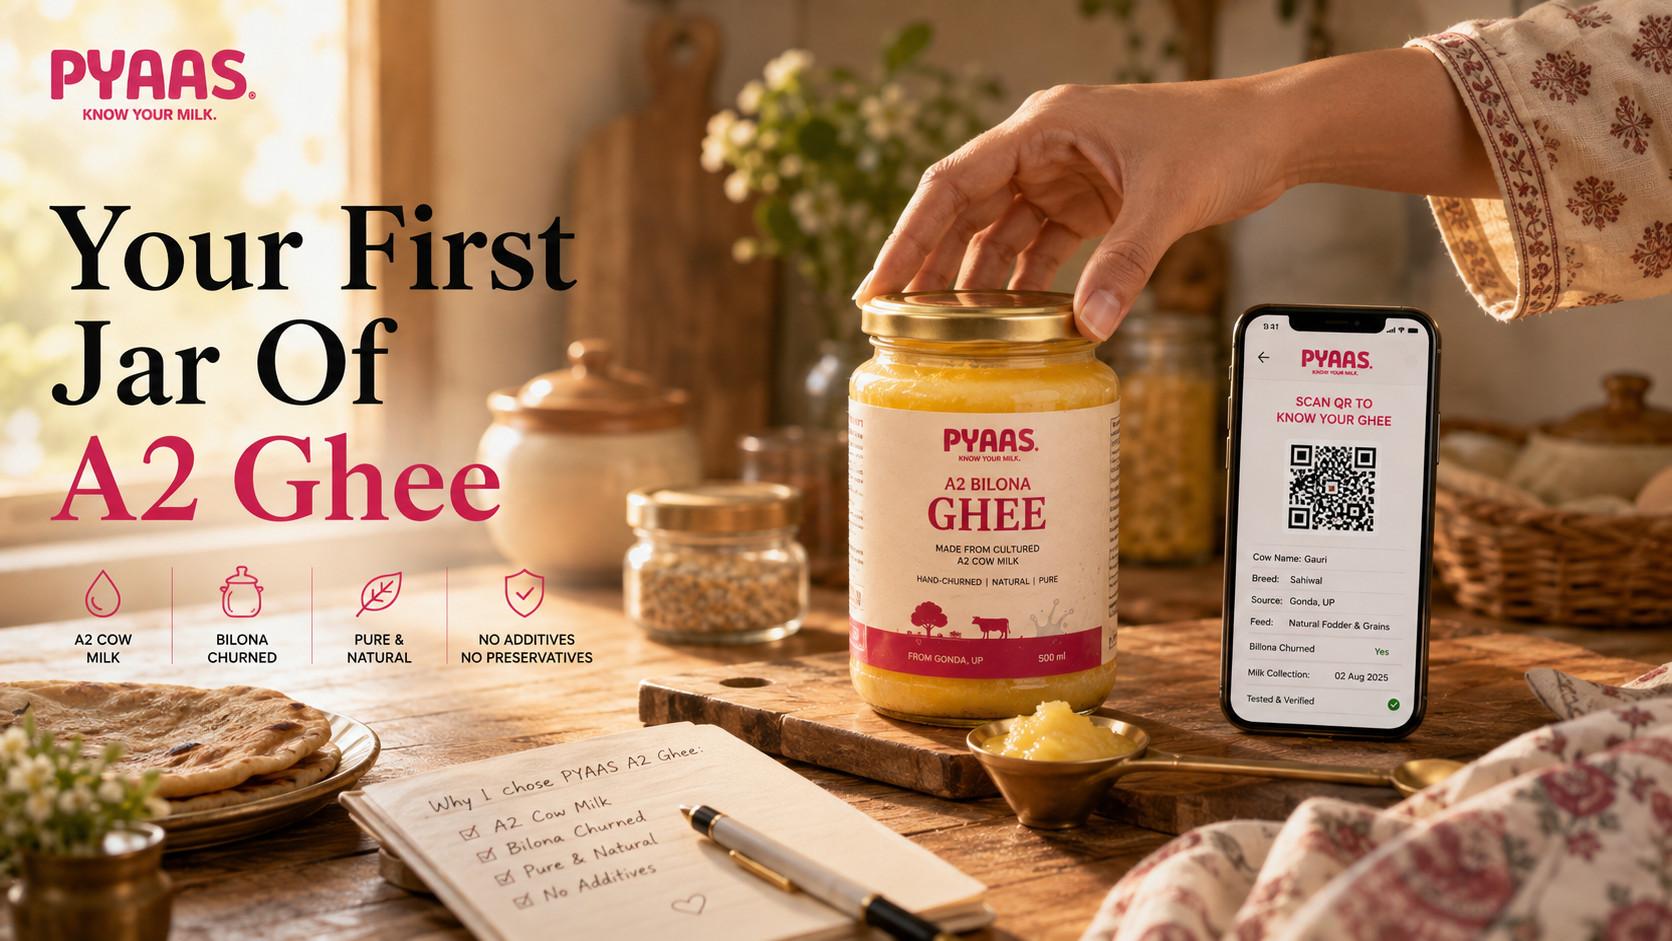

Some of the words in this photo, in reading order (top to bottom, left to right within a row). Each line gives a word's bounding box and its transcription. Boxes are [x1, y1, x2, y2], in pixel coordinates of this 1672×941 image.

[1295, 396, 1331, 408] SCAN
[1333, 397, 1352, 410] QR
[1355, 398, 1373, 409] TO
[1276, 412, 1317, 424] KNOW
[1319, 413, 1355, 426] YOUR
[1357, 415, 1392, 427] GHEE
[944, 477, 966, 491] A2
[971, 477, 1031, 491] BILONA
[927, 496, 1046, 532] GHEE
[935, 544, 962, 554] MADE
[964, 545, 991, 554] FROM
[993, 544, 1040, 554] CULTURED
[957, 556, 970, 566] A2
[972, 557, 995, 566] COW
[997, 556, 1019, 566] MILK
[1252, 552, 1272, 562] Cow
[1274, 554, 1302, 563] Name:
[1304, 555, 1328, 564] Gauri
[916, 575, 983, 587] HAND-CHURNED
[992, 577, 1030, 586] NATURAL
[1038, 575, 1059, 585] PURE
[1252, 574, 1280, 583] Breed:
[1290, 575, 1323, 585] Sahiwal
[1251, 596, 1283, 605] Source:
[1289, 597, 1321, 607] Gonda,
[1322, 598, 1335, 607] UP
[1250, 617, 1274, 627] Feed:
[1288, 619, 1320, 629] Natural
[1321, 620, 1353, 630] Fodder
[1353, 621, 1361, 631] &
[1362, 622, 1391, 632] Grains
[1249, 643, 1277, 652] Billona
[1279, 644, 1315, 654] Churned
[1374, 647, 1390, 656] Yes
[908, 652, 932, 663] FROM
[971, 656, 984, 665] UP
[1038, 653, 1055, 663] 500
[1056, 651, 1066, 662] ml
[1247, 668, 1265, 678] Milk
[1266, 669, 1311, 679] Collection:
[1334, 671, 1347, 681] 02
[1348, 672, 1365, 683] Aug
[1366, 673, 1389, 682] 2025
[1246, 694, 1274, 704] Tested
[1275, 695, 1282, 704] &
[1283, 696, 1315, 706] Verified
[428, 795, 473, 813] Why
[481, 788, 493, 801] I
[502, 777, 555, 797] chose
[561, 760, 619, 784] PYAAS
[627, 755, 652, 769] A2
[657, 746, 704, 763] Ghee:
[494, 816, 524, 834] A2
[531, 808, 567, 823] Cow
[574, 795, 613, 814] Milk
[506, 833, 565, 856] Bilona
[573, 810, 648, 839] Churned
[523, 860, 566, 879] Pure
[572, 852, 587, 866] &
[593, 832, 659, 860] Natural
[543, 886, 569, 902] No
[578, 863, 658, 893] Additives
